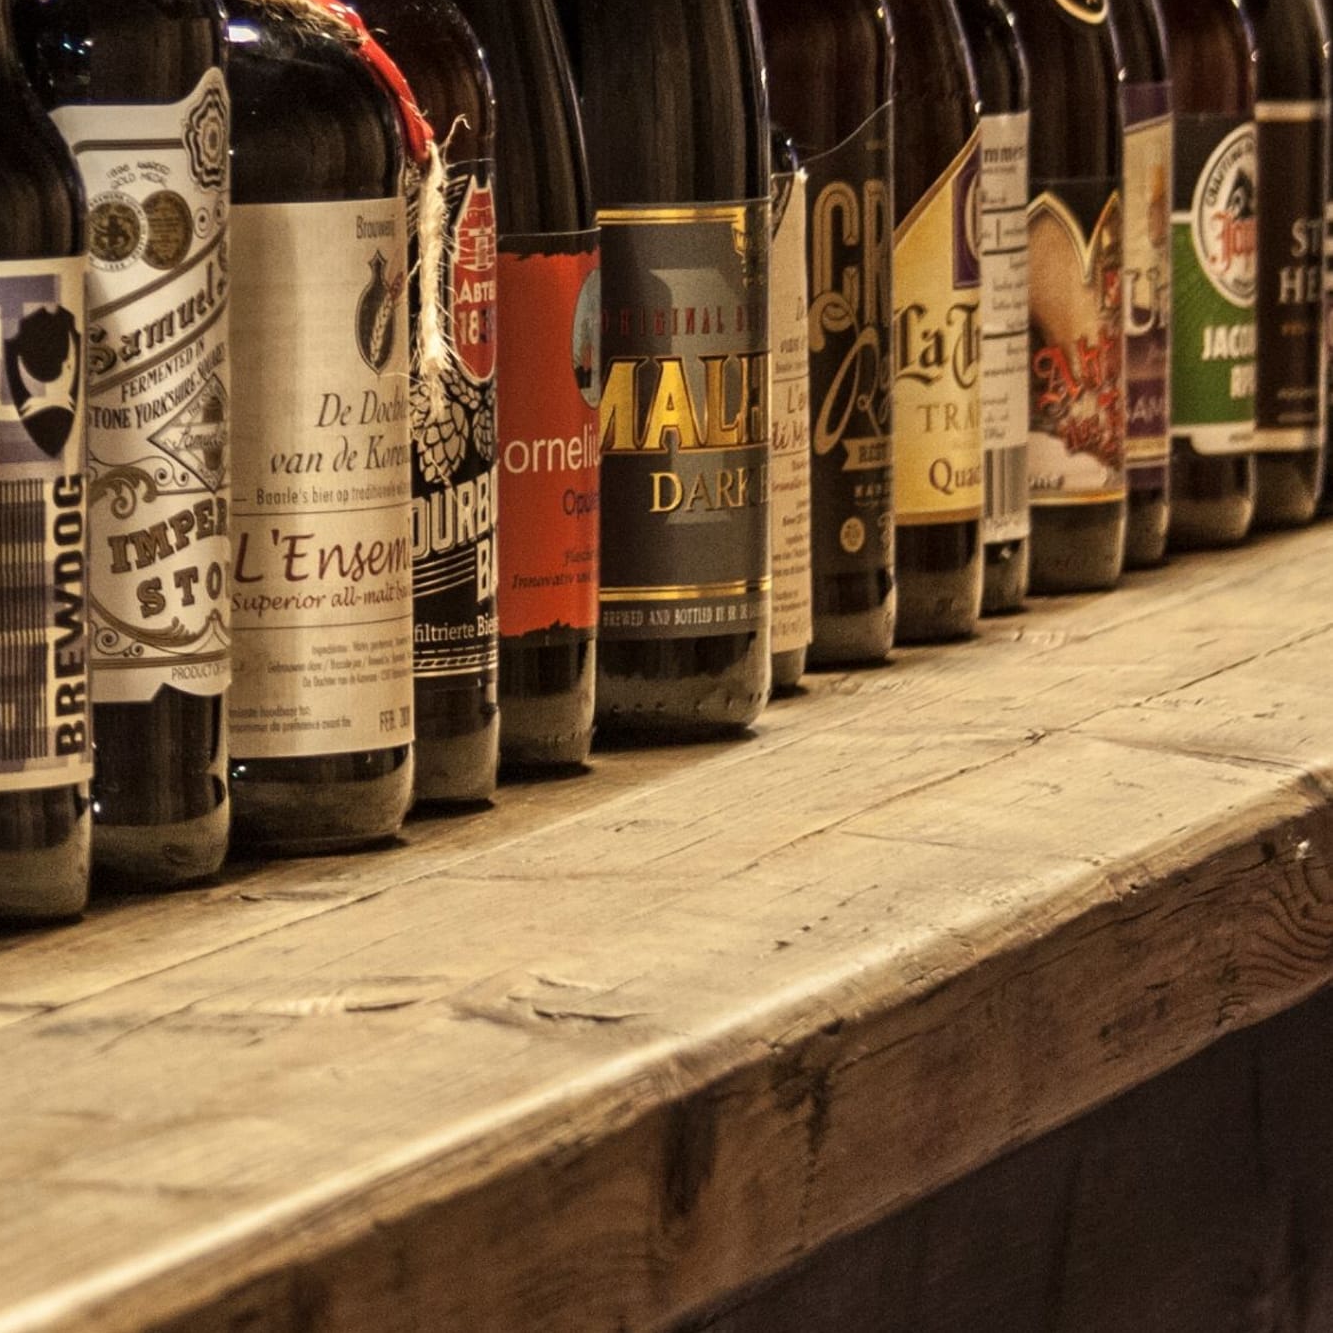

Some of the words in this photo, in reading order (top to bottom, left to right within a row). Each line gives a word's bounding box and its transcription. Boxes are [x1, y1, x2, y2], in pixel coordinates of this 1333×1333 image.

[120, 347, 199, 403] FERMENTED
[134, 369, 198, 429] YORKSHIRE
[316, 392, 353, 428] De
[271, 452, 323, 475] van
[332, 435, 358, 473] de
[312, 484, 333, 504] bier
[336, 482, 349, 503] op
[53, 473, 85, 757] BREWDOG
[231, 588, 327, 616] Superior
[674, 608, 713, 626] BOTTLED
